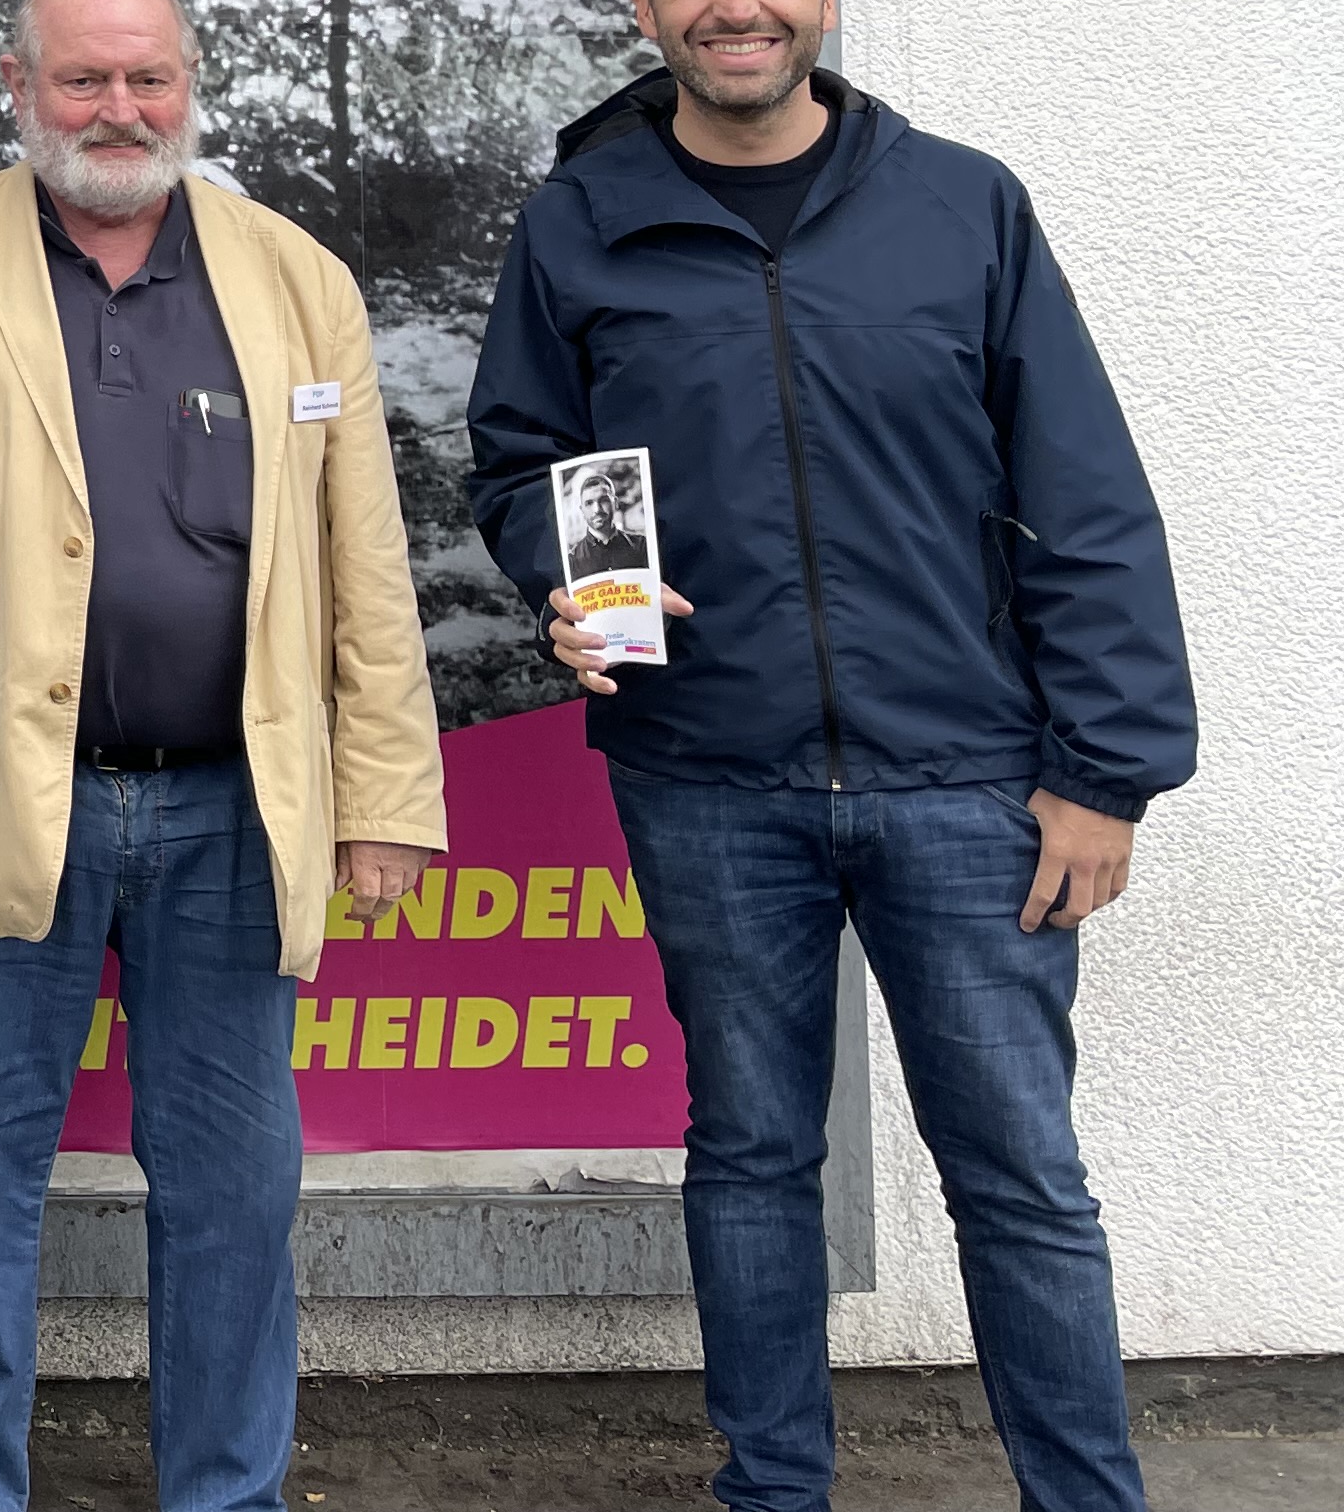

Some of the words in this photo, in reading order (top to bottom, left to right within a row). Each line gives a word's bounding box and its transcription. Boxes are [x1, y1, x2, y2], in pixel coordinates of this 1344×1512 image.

[598, 586, 621, 598] GAB
[625, 585, 639, 594] ES
[602, 597, 617, 608] ZU
[620, 595, 648, 606] TUN.
